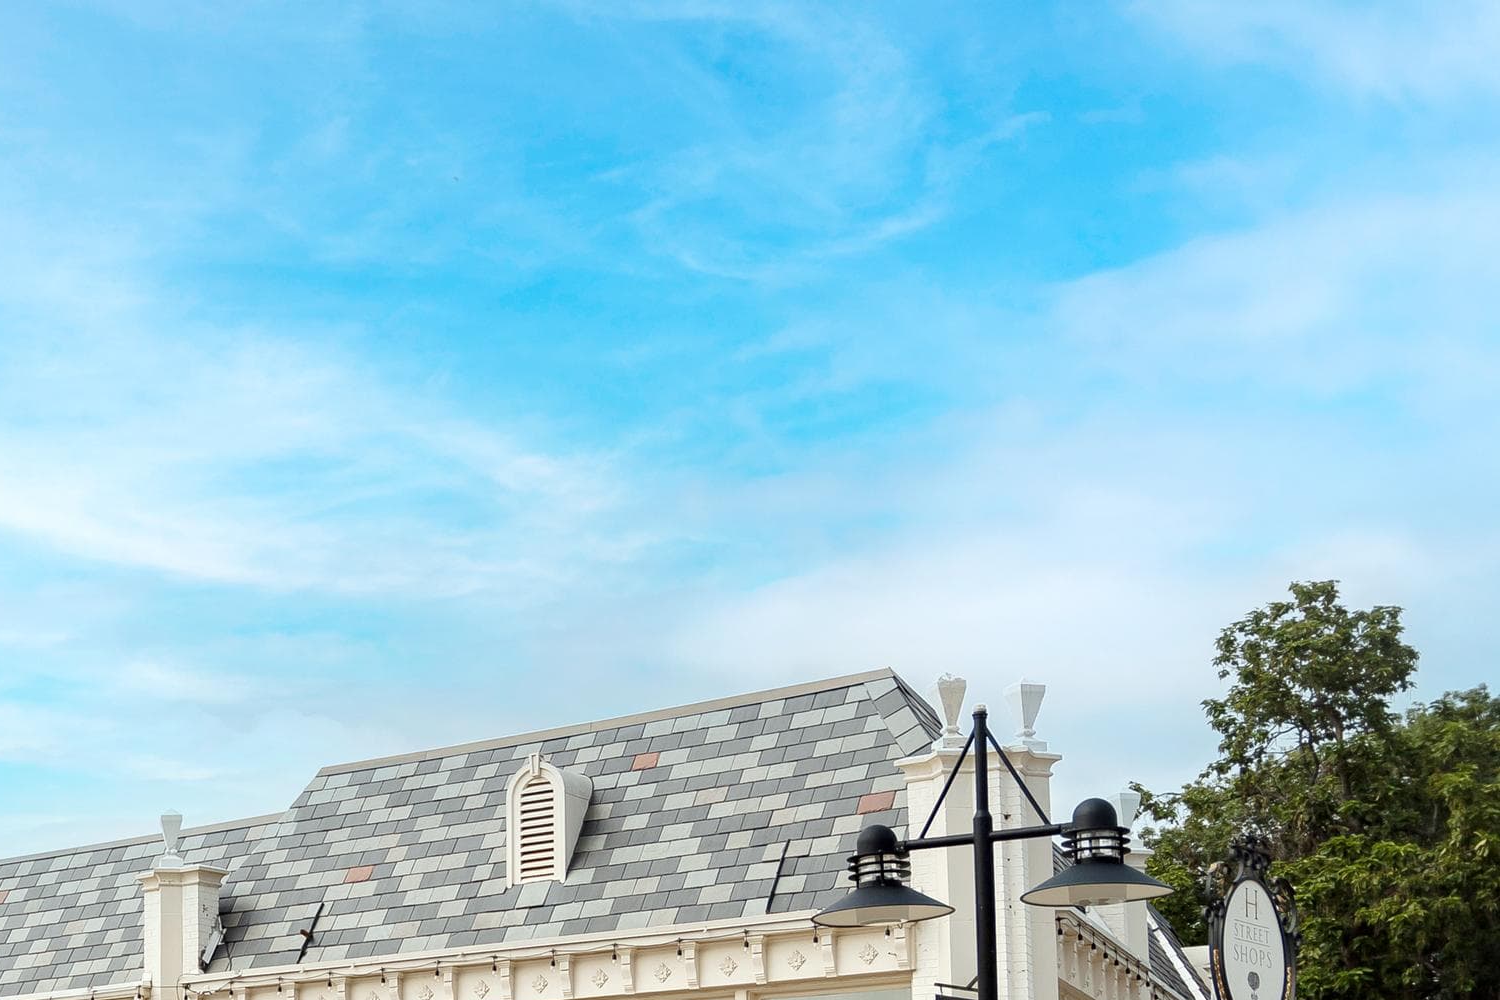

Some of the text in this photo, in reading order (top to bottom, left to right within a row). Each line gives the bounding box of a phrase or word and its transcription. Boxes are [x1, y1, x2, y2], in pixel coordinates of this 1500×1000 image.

[1245, 887, 1258, 920] H
[1234, 923, 1269, 944] STREET
[1233, 944, 1273, 969] SHOPS
